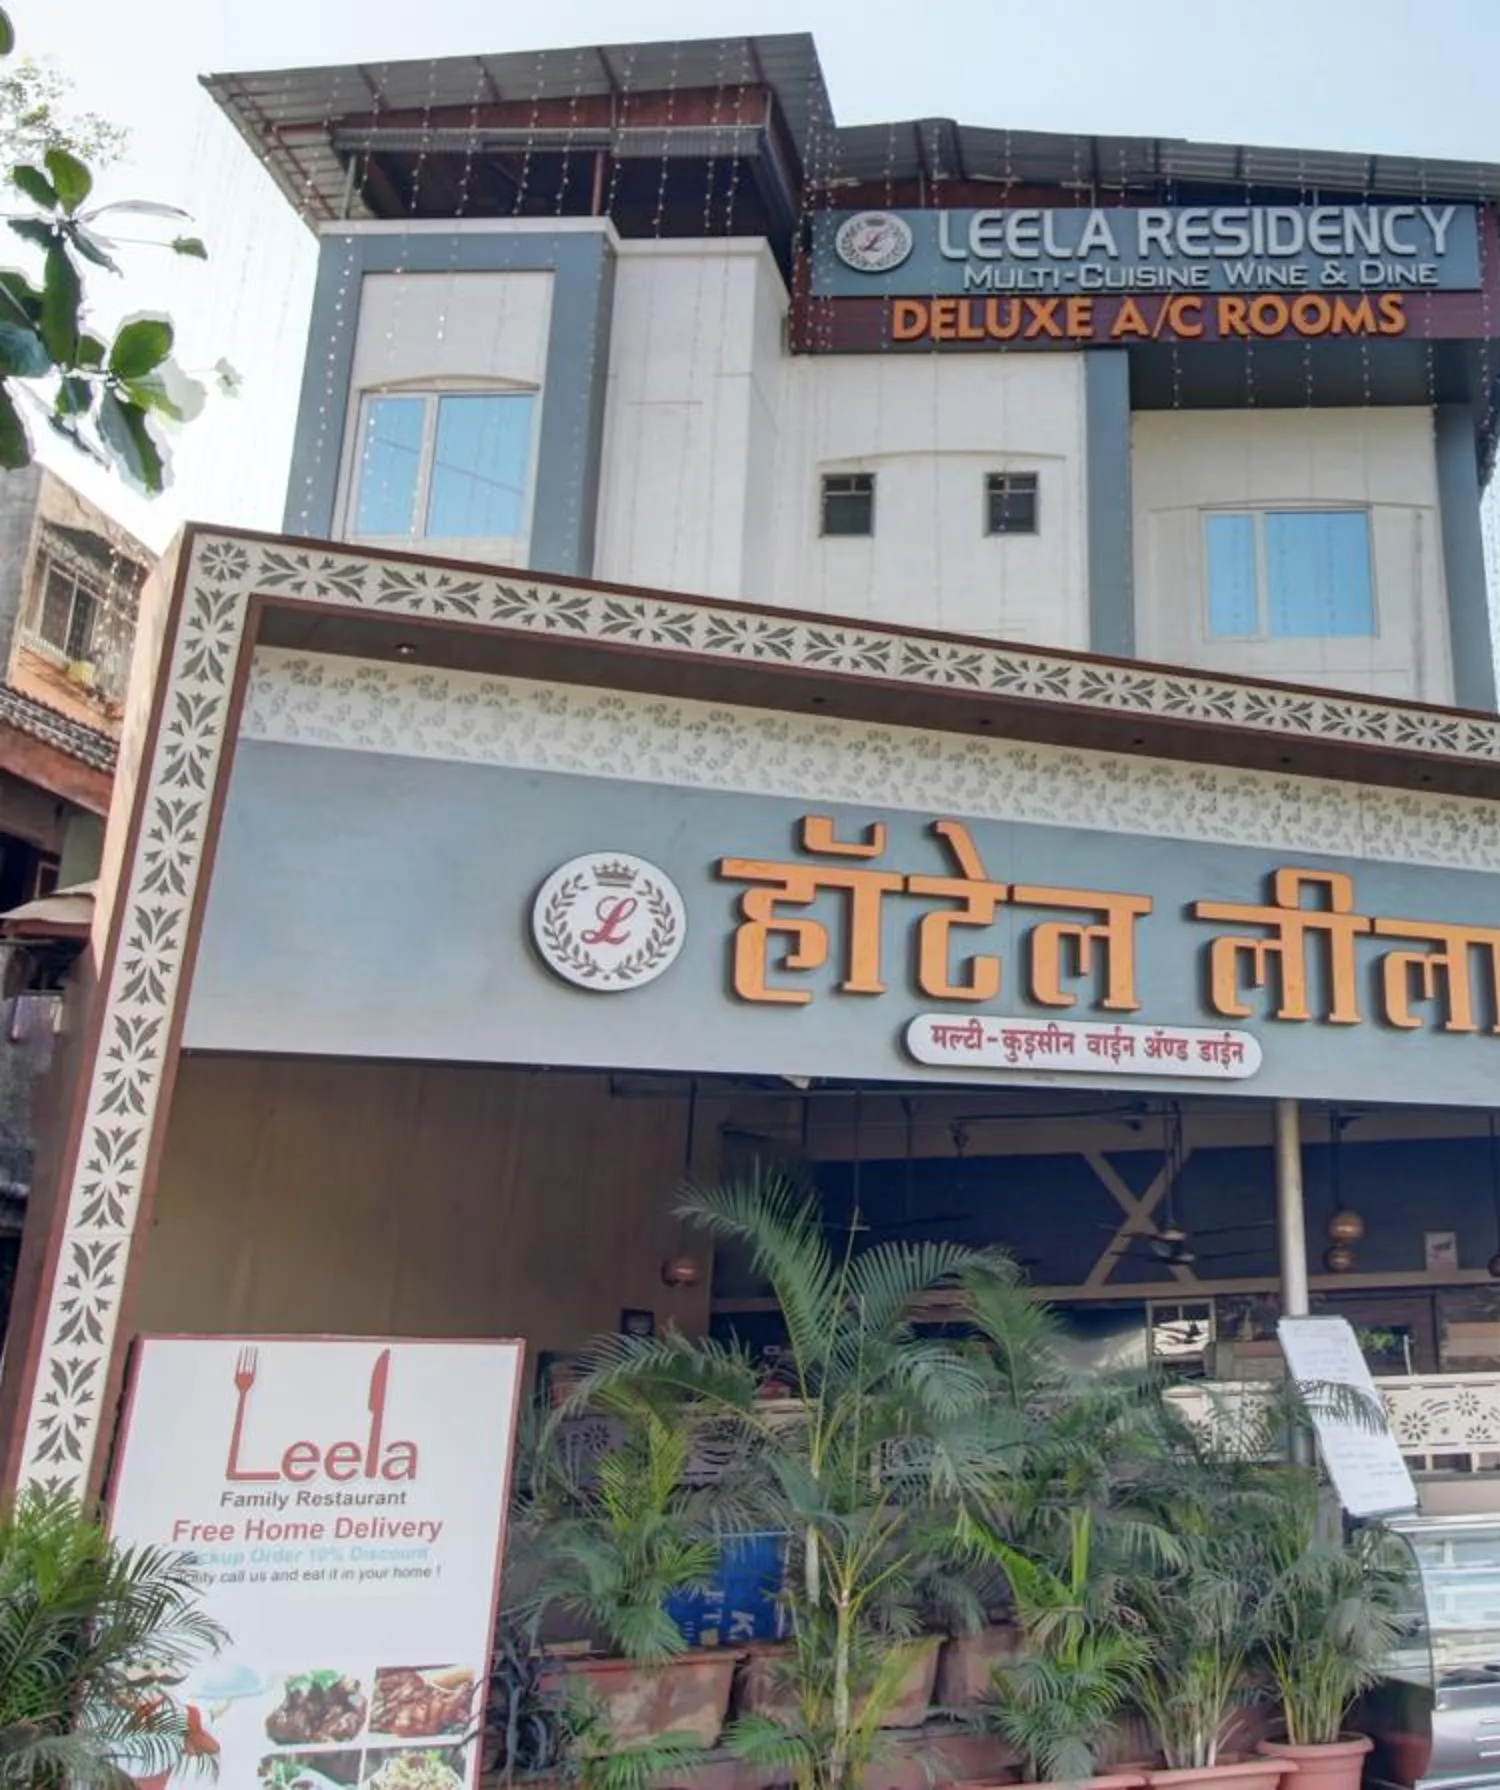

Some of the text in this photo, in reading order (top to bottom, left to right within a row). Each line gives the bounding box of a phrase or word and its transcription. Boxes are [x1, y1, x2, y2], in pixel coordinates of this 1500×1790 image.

[937, 206, 1455, 260] LEELA RESIDENCY
[963, 261, 1438, 291] MULTI-CUISINE WINE & DINE
[892, 293, 1406, 341] DELUXE A/C ROOMS
[226, 1346, 418, 1482] Leela
[220, 1490, 407, 1511] Family Restaurant
[172, 1516, 443, 1543] Free Home Delivery
[250, 1546, 302, 1564] Order
[350, 1544, 428, 1562] Discount
[221, 1569, 246, 1582] call
[249, 1571, 265, 1582] us
[271, 1568, 299, 1582] and
[303, 1568, 325, 1581] eat
[341, 1567, 354, 1580] in
[359, 1567, 388, 1584] your
[393, 1565, 432, 1579] home
